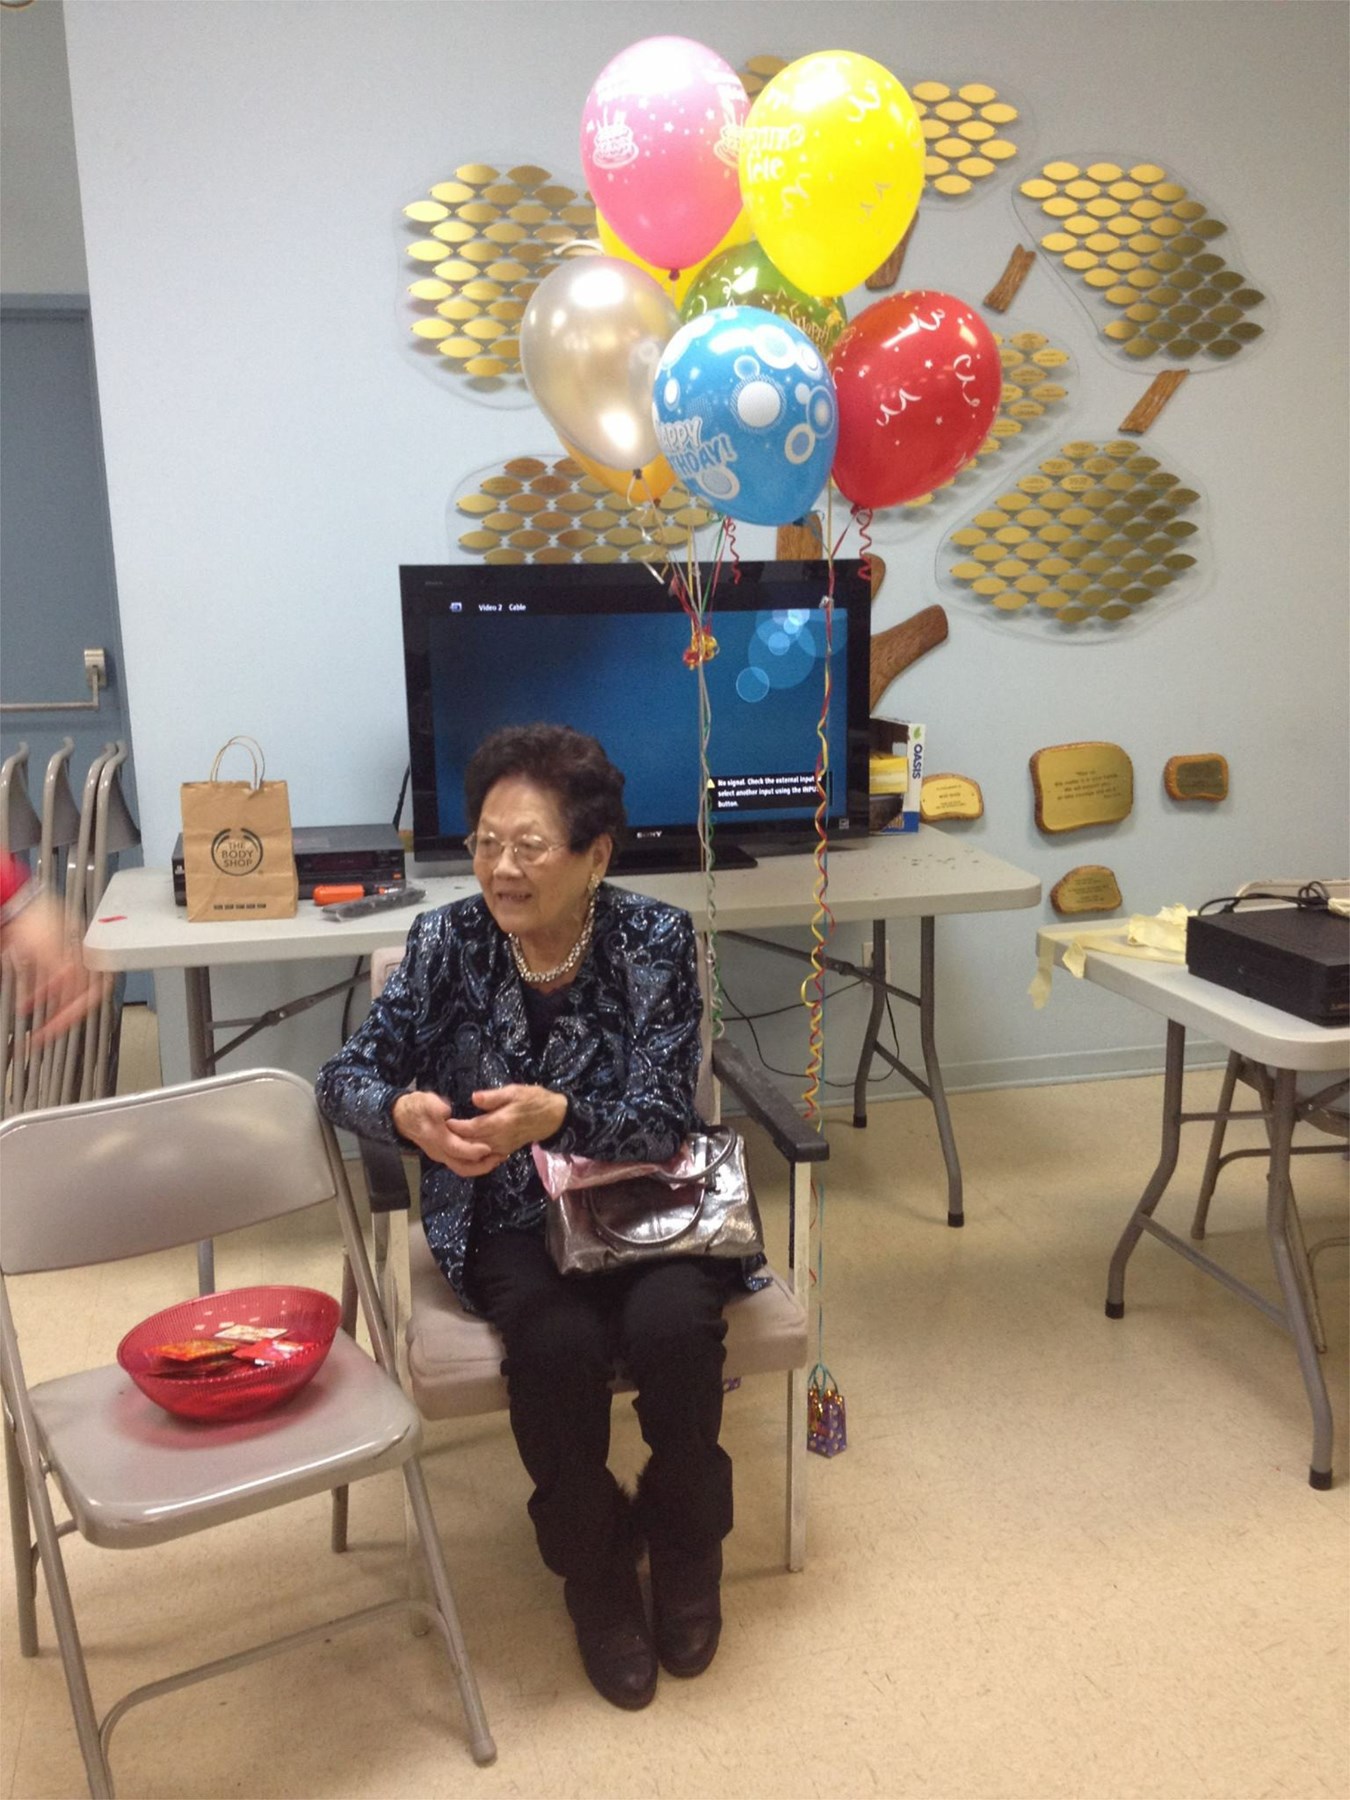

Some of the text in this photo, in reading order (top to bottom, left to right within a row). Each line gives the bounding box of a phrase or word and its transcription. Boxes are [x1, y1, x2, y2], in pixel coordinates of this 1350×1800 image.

[657, 416, 703, 453] APPY
[478, 603, 527, 612] Video 2 Cable
[912, 743, 923, 780] OASIS
[727, 779, 745, 787] signal.
[775, 776, 799, 784] external
[800, 775, 815, 784] input
[759, 788, 774, 796] input
[775, 787, 791, 796] using
[222, 850, 253, 858] BODY
[223, 859, 252, 867] SHOP
